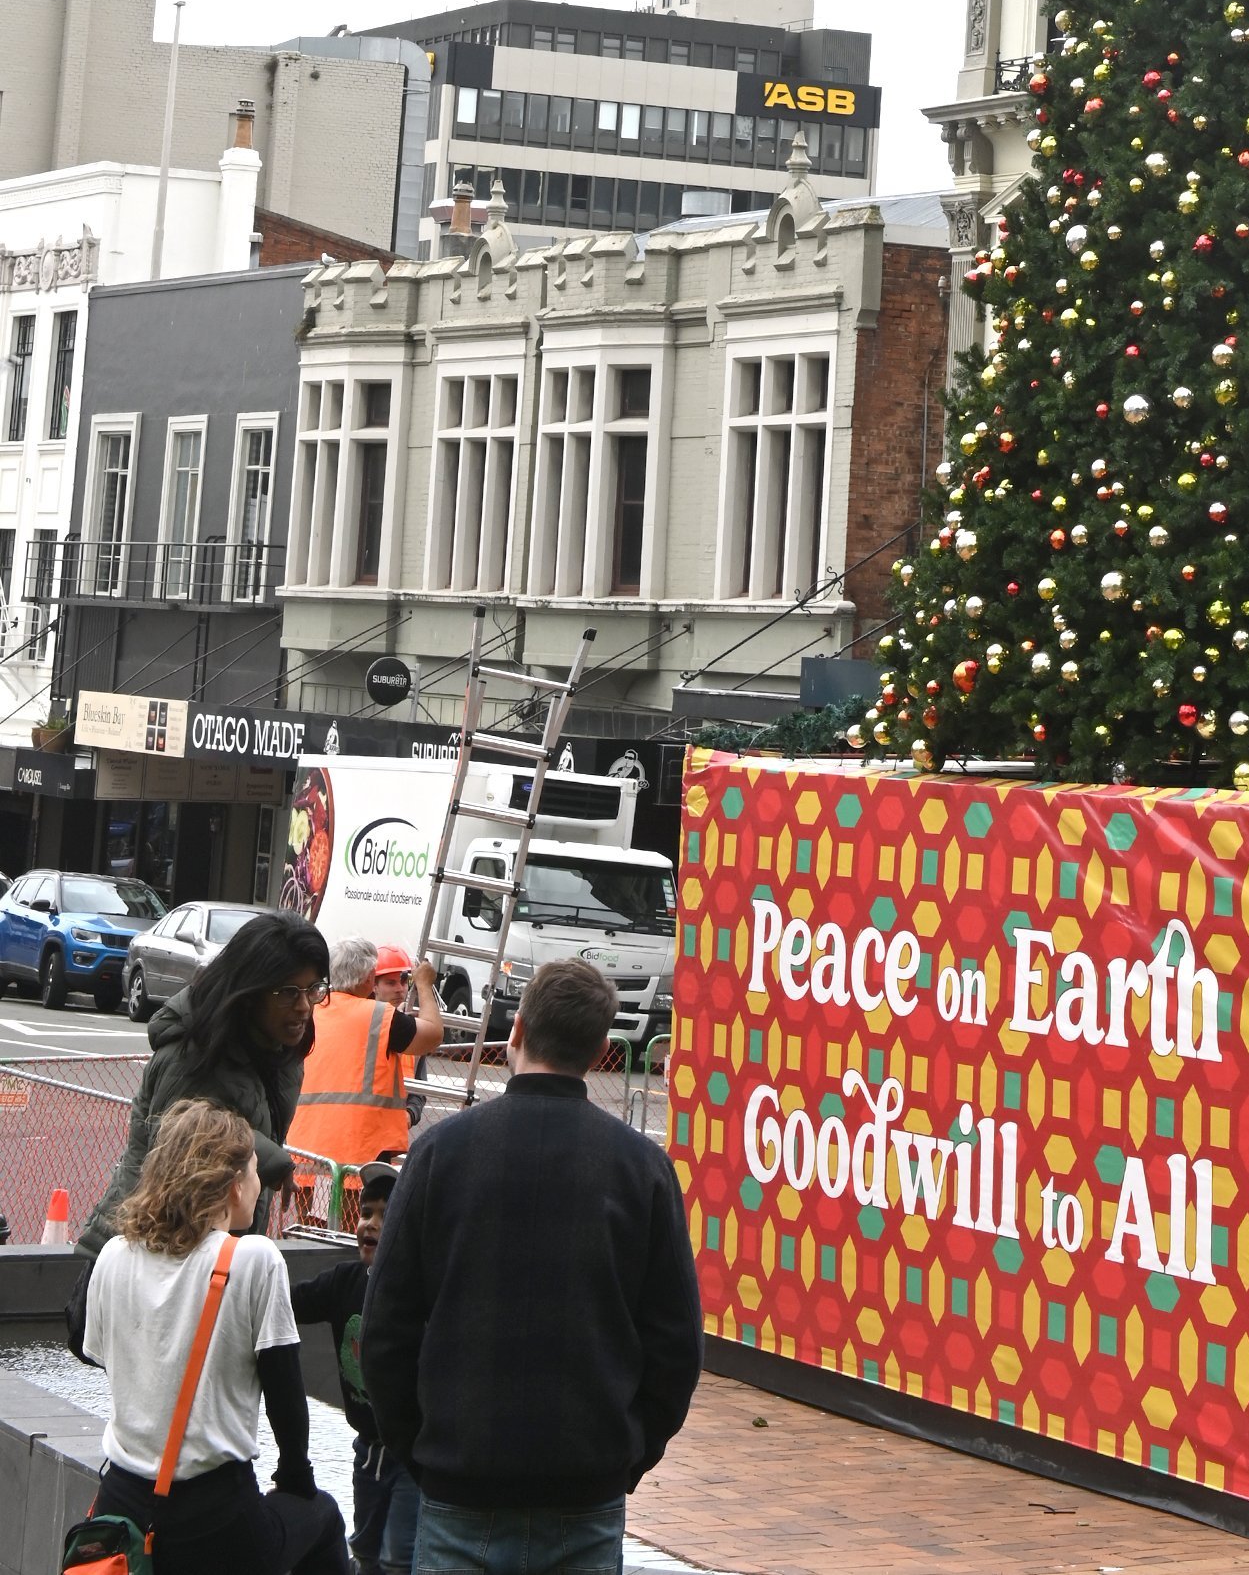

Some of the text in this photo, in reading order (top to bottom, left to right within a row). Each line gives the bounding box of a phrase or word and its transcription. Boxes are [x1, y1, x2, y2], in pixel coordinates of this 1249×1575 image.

[764, 81, 856, 116] ASB
[372, 674, 408, 686] SUBURBIA
[83, 703, 111, 724] Blueskin
[112, 706, 126, 726] Bay
[192, 713, 250, 754] OTAGO
[253, 719, 305, 760] MADE
[361, 838, 430, 879] Bidfood
[344, 886, 423, 906] Passionate about foodservice
[586, 950, 620, 963] Bidfood
[748, 899, 1223, 1063] Peace on Earth
[744, 1068, 1020, 1240] Goodwill
[1040, 1175, 1084, 1253] to
[1104, 1153, 1217, 1286] All
